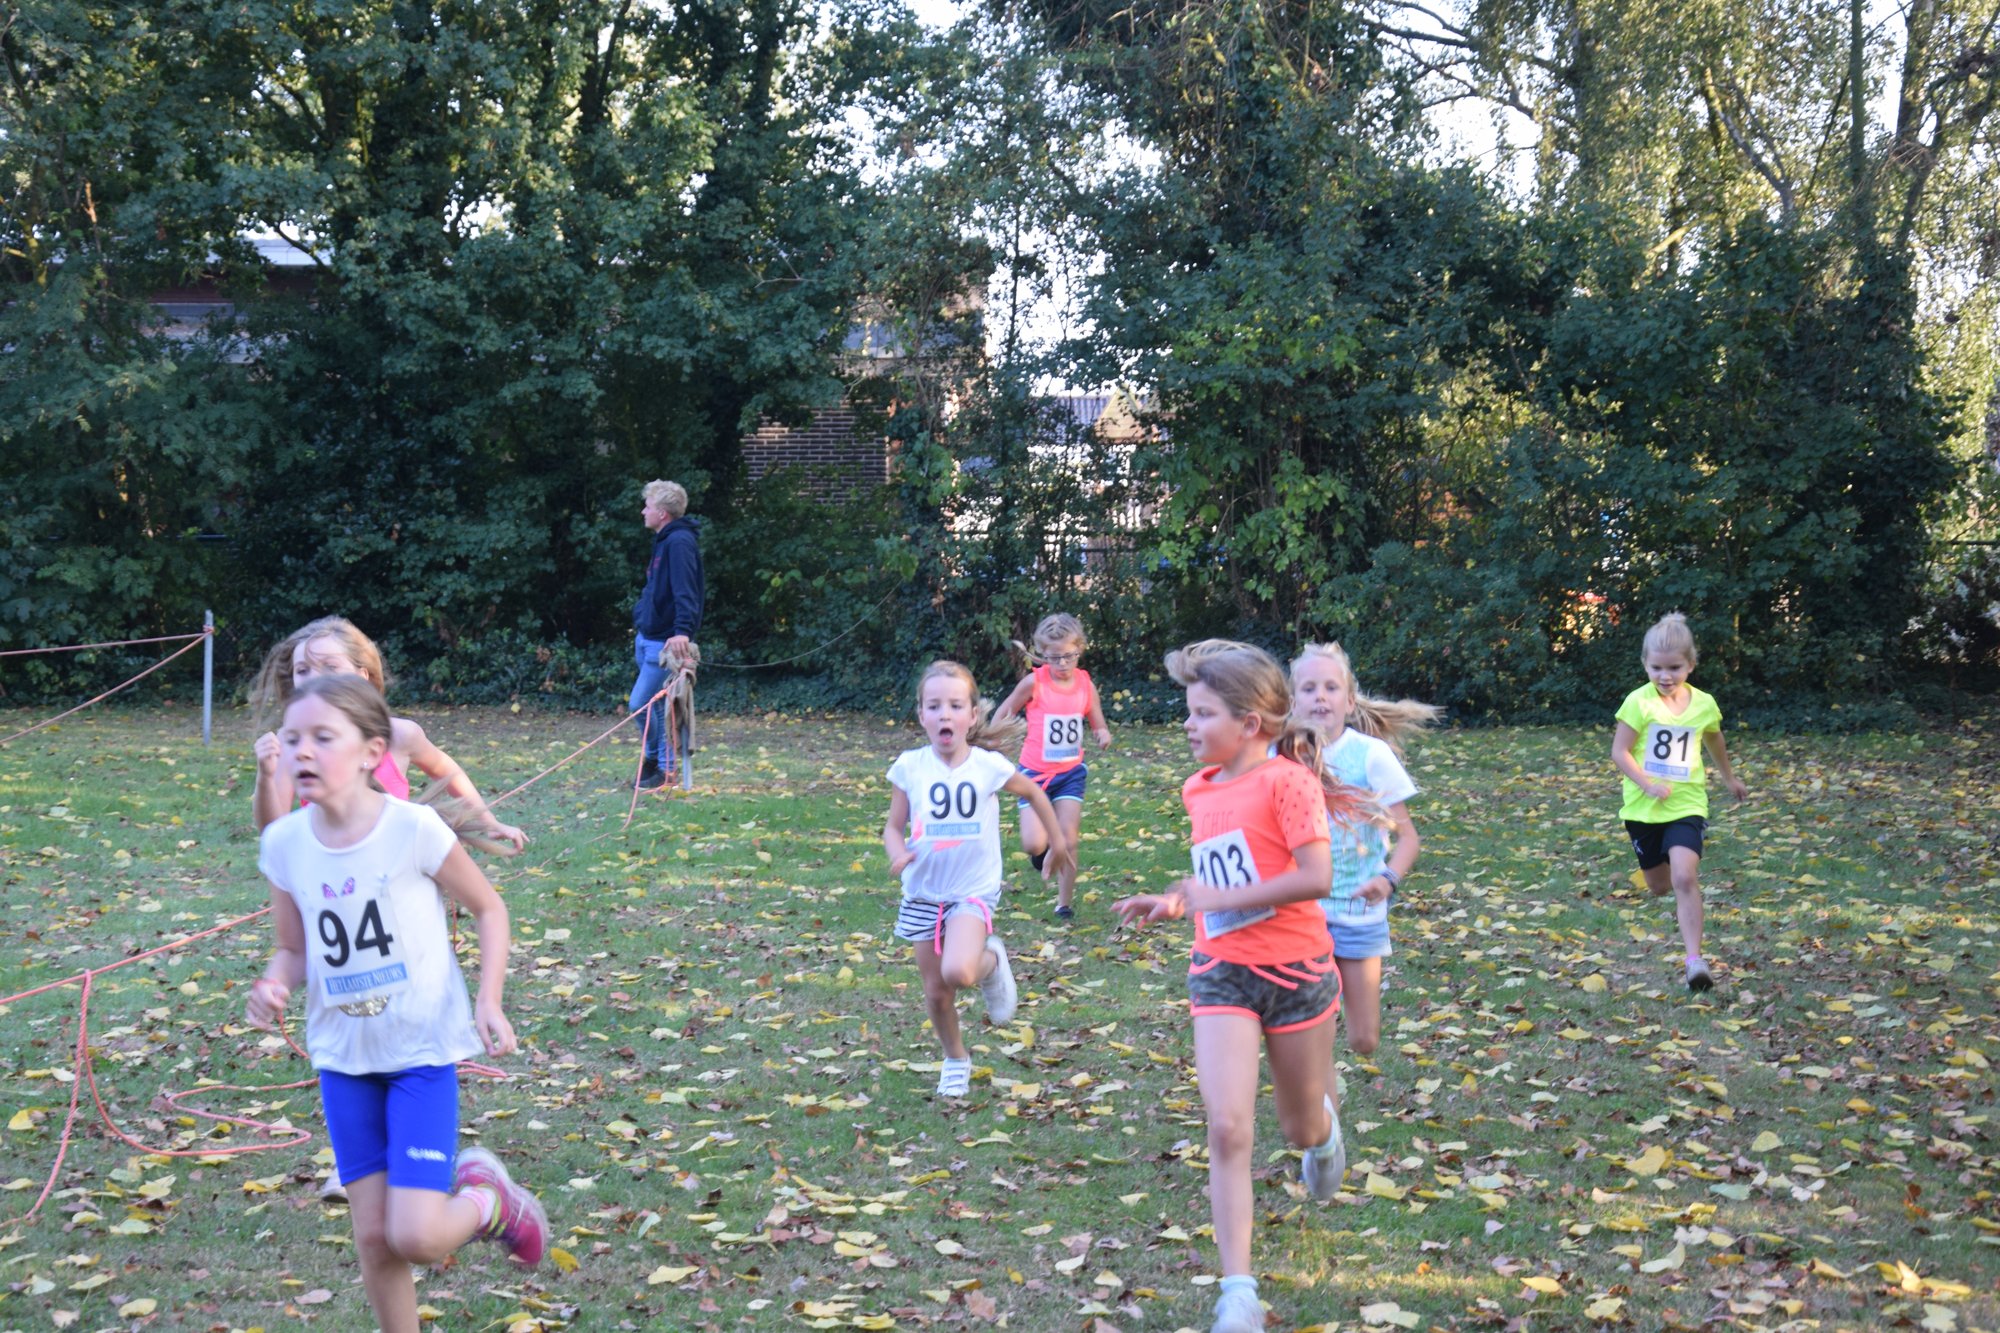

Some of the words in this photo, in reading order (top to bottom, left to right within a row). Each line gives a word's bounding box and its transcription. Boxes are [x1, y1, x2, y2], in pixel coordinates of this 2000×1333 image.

[1050, 719, 1078, 745] 88
[1653, 729, 1689, 762] 81
[929, 781, 977, 820] 90
[1199, 844, 1251, 889] 103
[318, 899, 393, 967] 94
